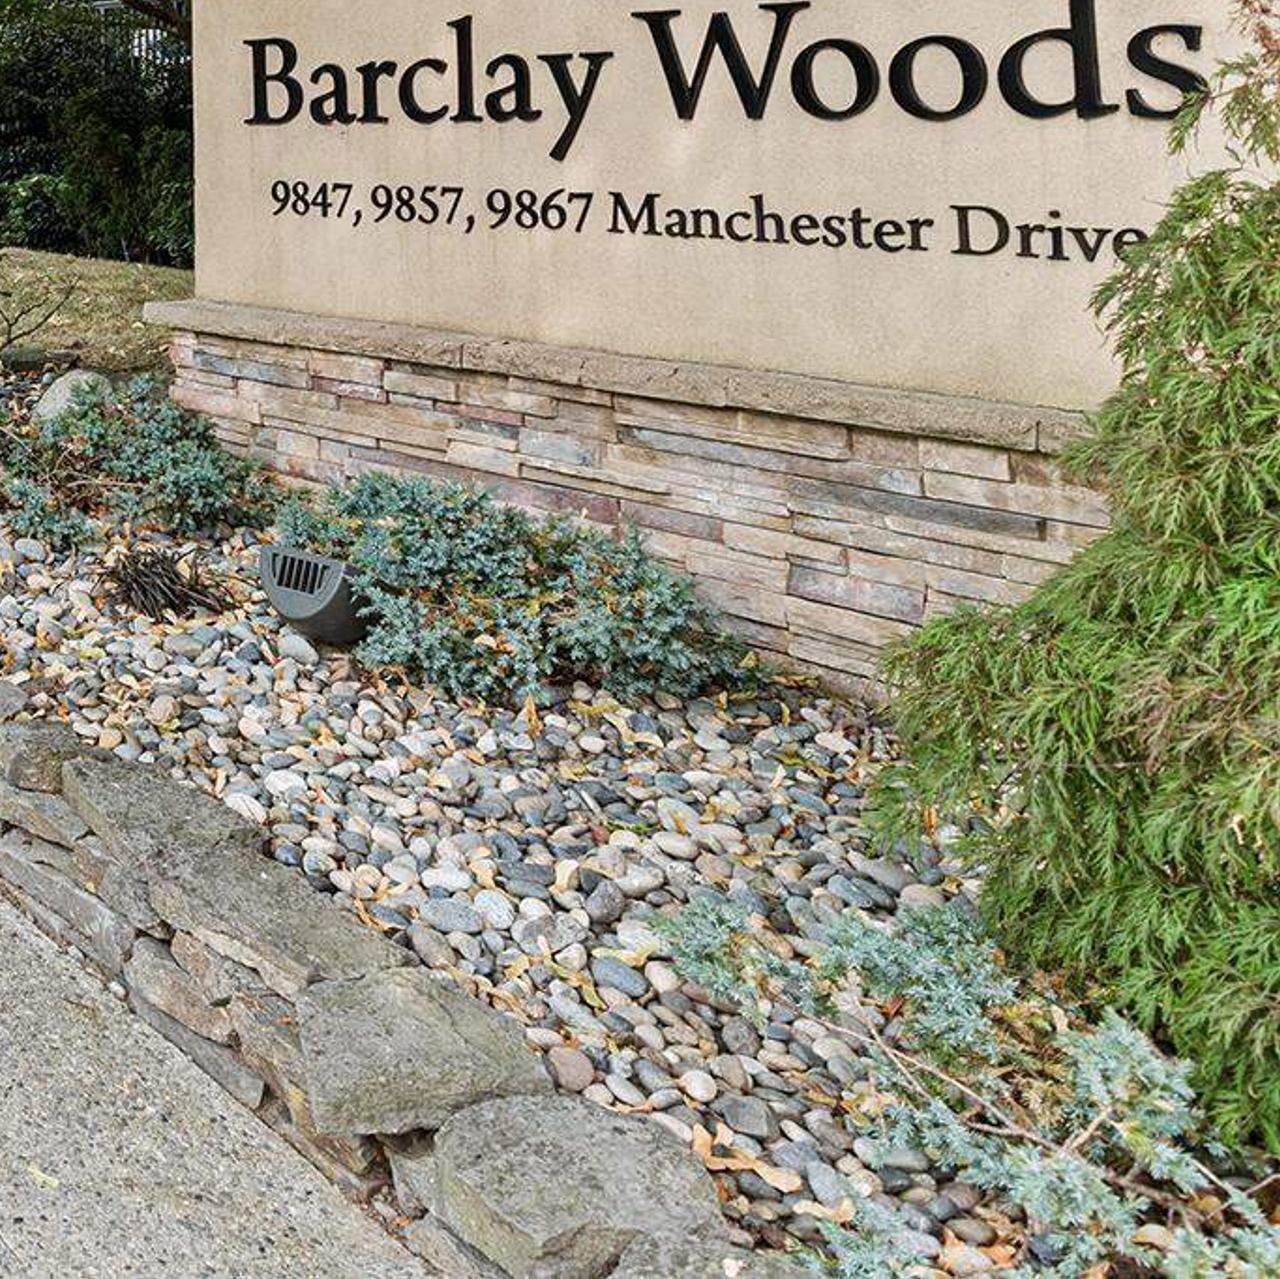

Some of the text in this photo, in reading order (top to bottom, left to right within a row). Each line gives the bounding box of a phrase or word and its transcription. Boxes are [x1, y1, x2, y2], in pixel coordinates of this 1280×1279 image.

[242, 14, 614, 163] Barclay
[270, 179, 1151, 264] 9847, 9857, 9867 Manchester Drive
